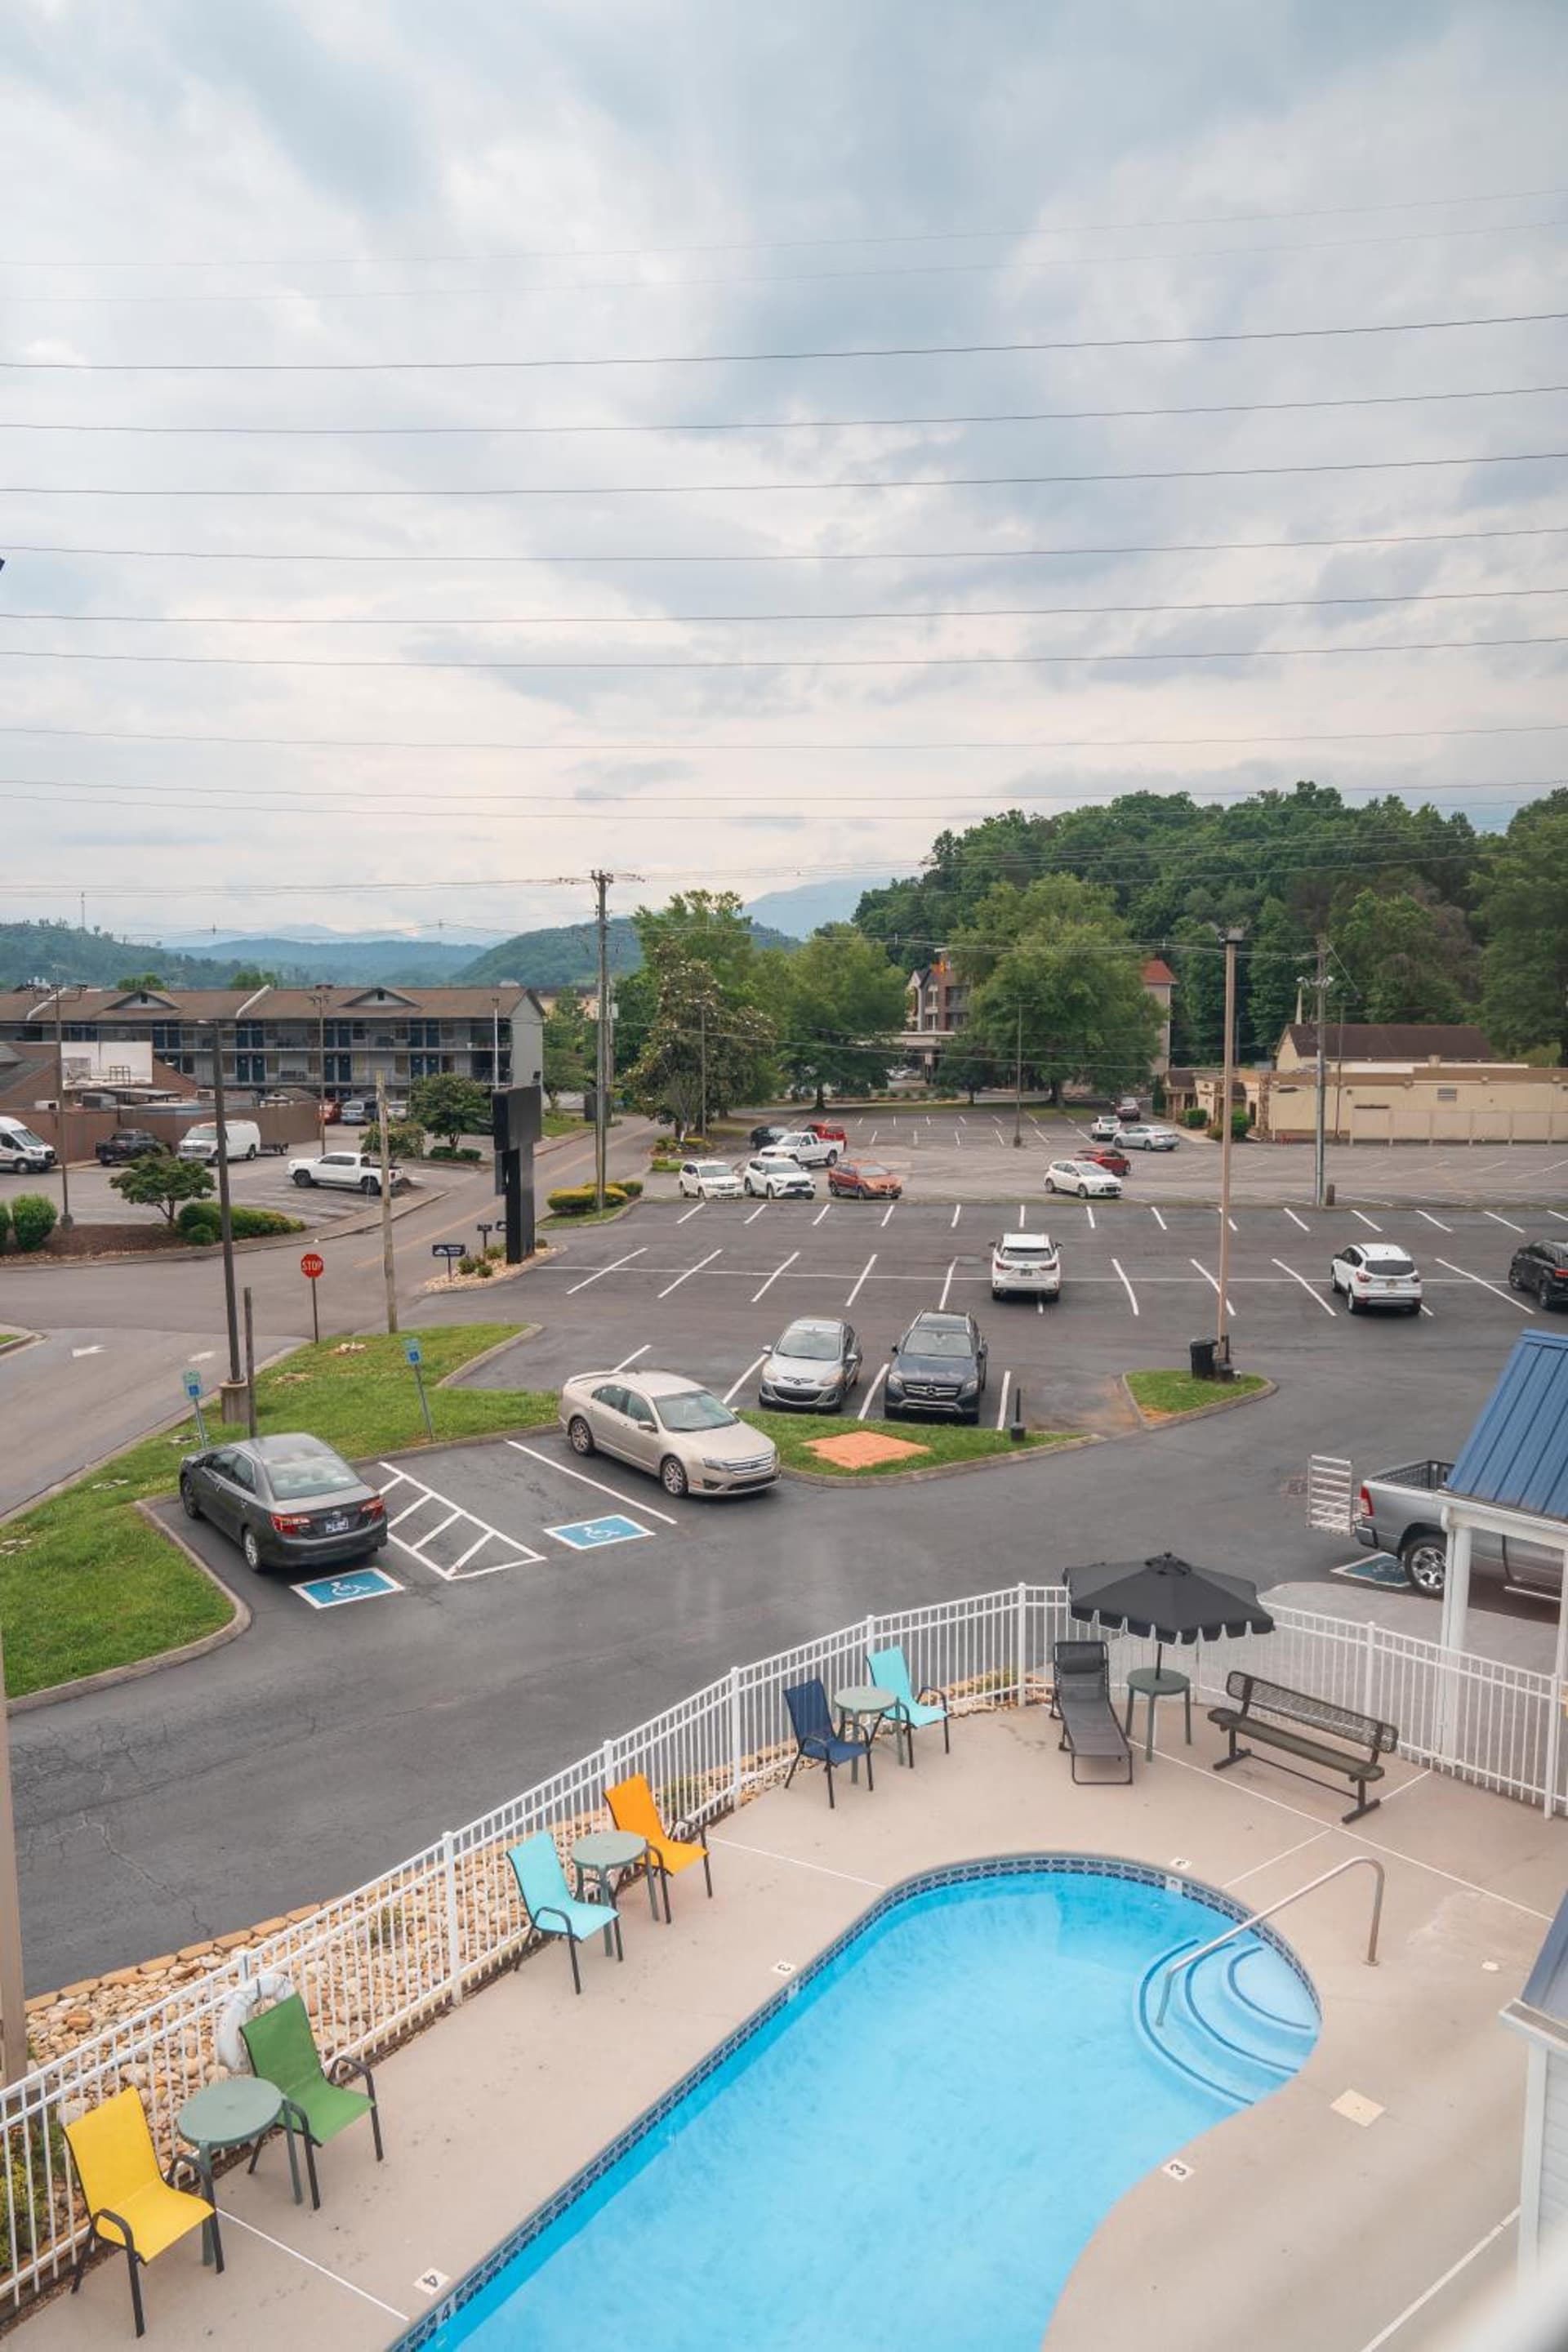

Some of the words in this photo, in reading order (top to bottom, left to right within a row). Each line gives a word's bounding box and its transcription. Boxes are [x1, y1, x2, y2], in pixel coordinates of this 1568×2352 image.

[302, 1260, 322, 1271] STOP
[1170, 2163, 1187, 2176] 3
[422, 2274, 438, 2288] 4
